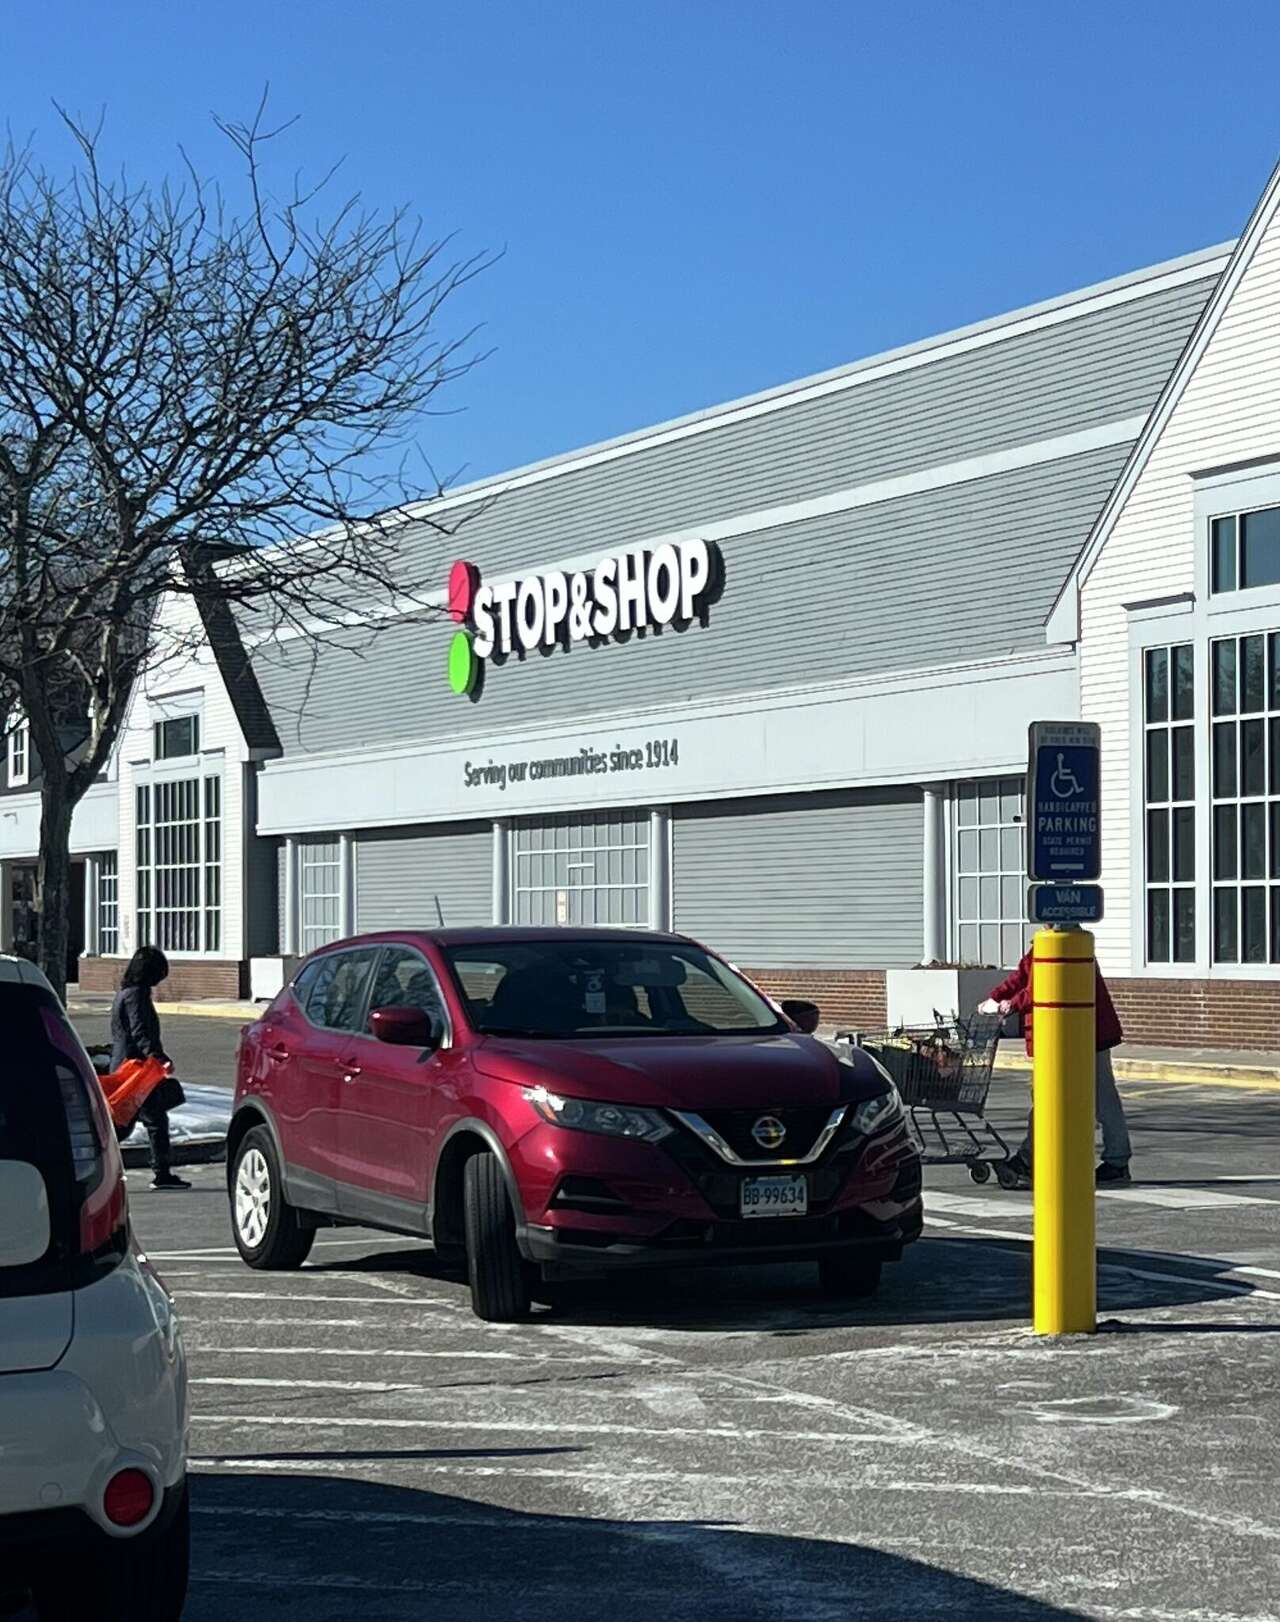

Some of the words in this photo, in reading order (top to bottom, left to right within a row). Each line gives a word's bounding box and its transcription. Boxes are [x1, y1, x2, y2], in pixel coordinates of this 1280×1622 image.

[464, 758, 507, 791] Serving
[508, 762, 528, 782] our
[529, 746, 607, 780] communities
[609, 743, 643, 772] since
[645, 738, 679, 768] 1914
[1038, 817, 1097, 833] PARKING
[1056, 890, 1081, 903] VAN
[1041, 906, 1097, 918] ACCESSIBLE
